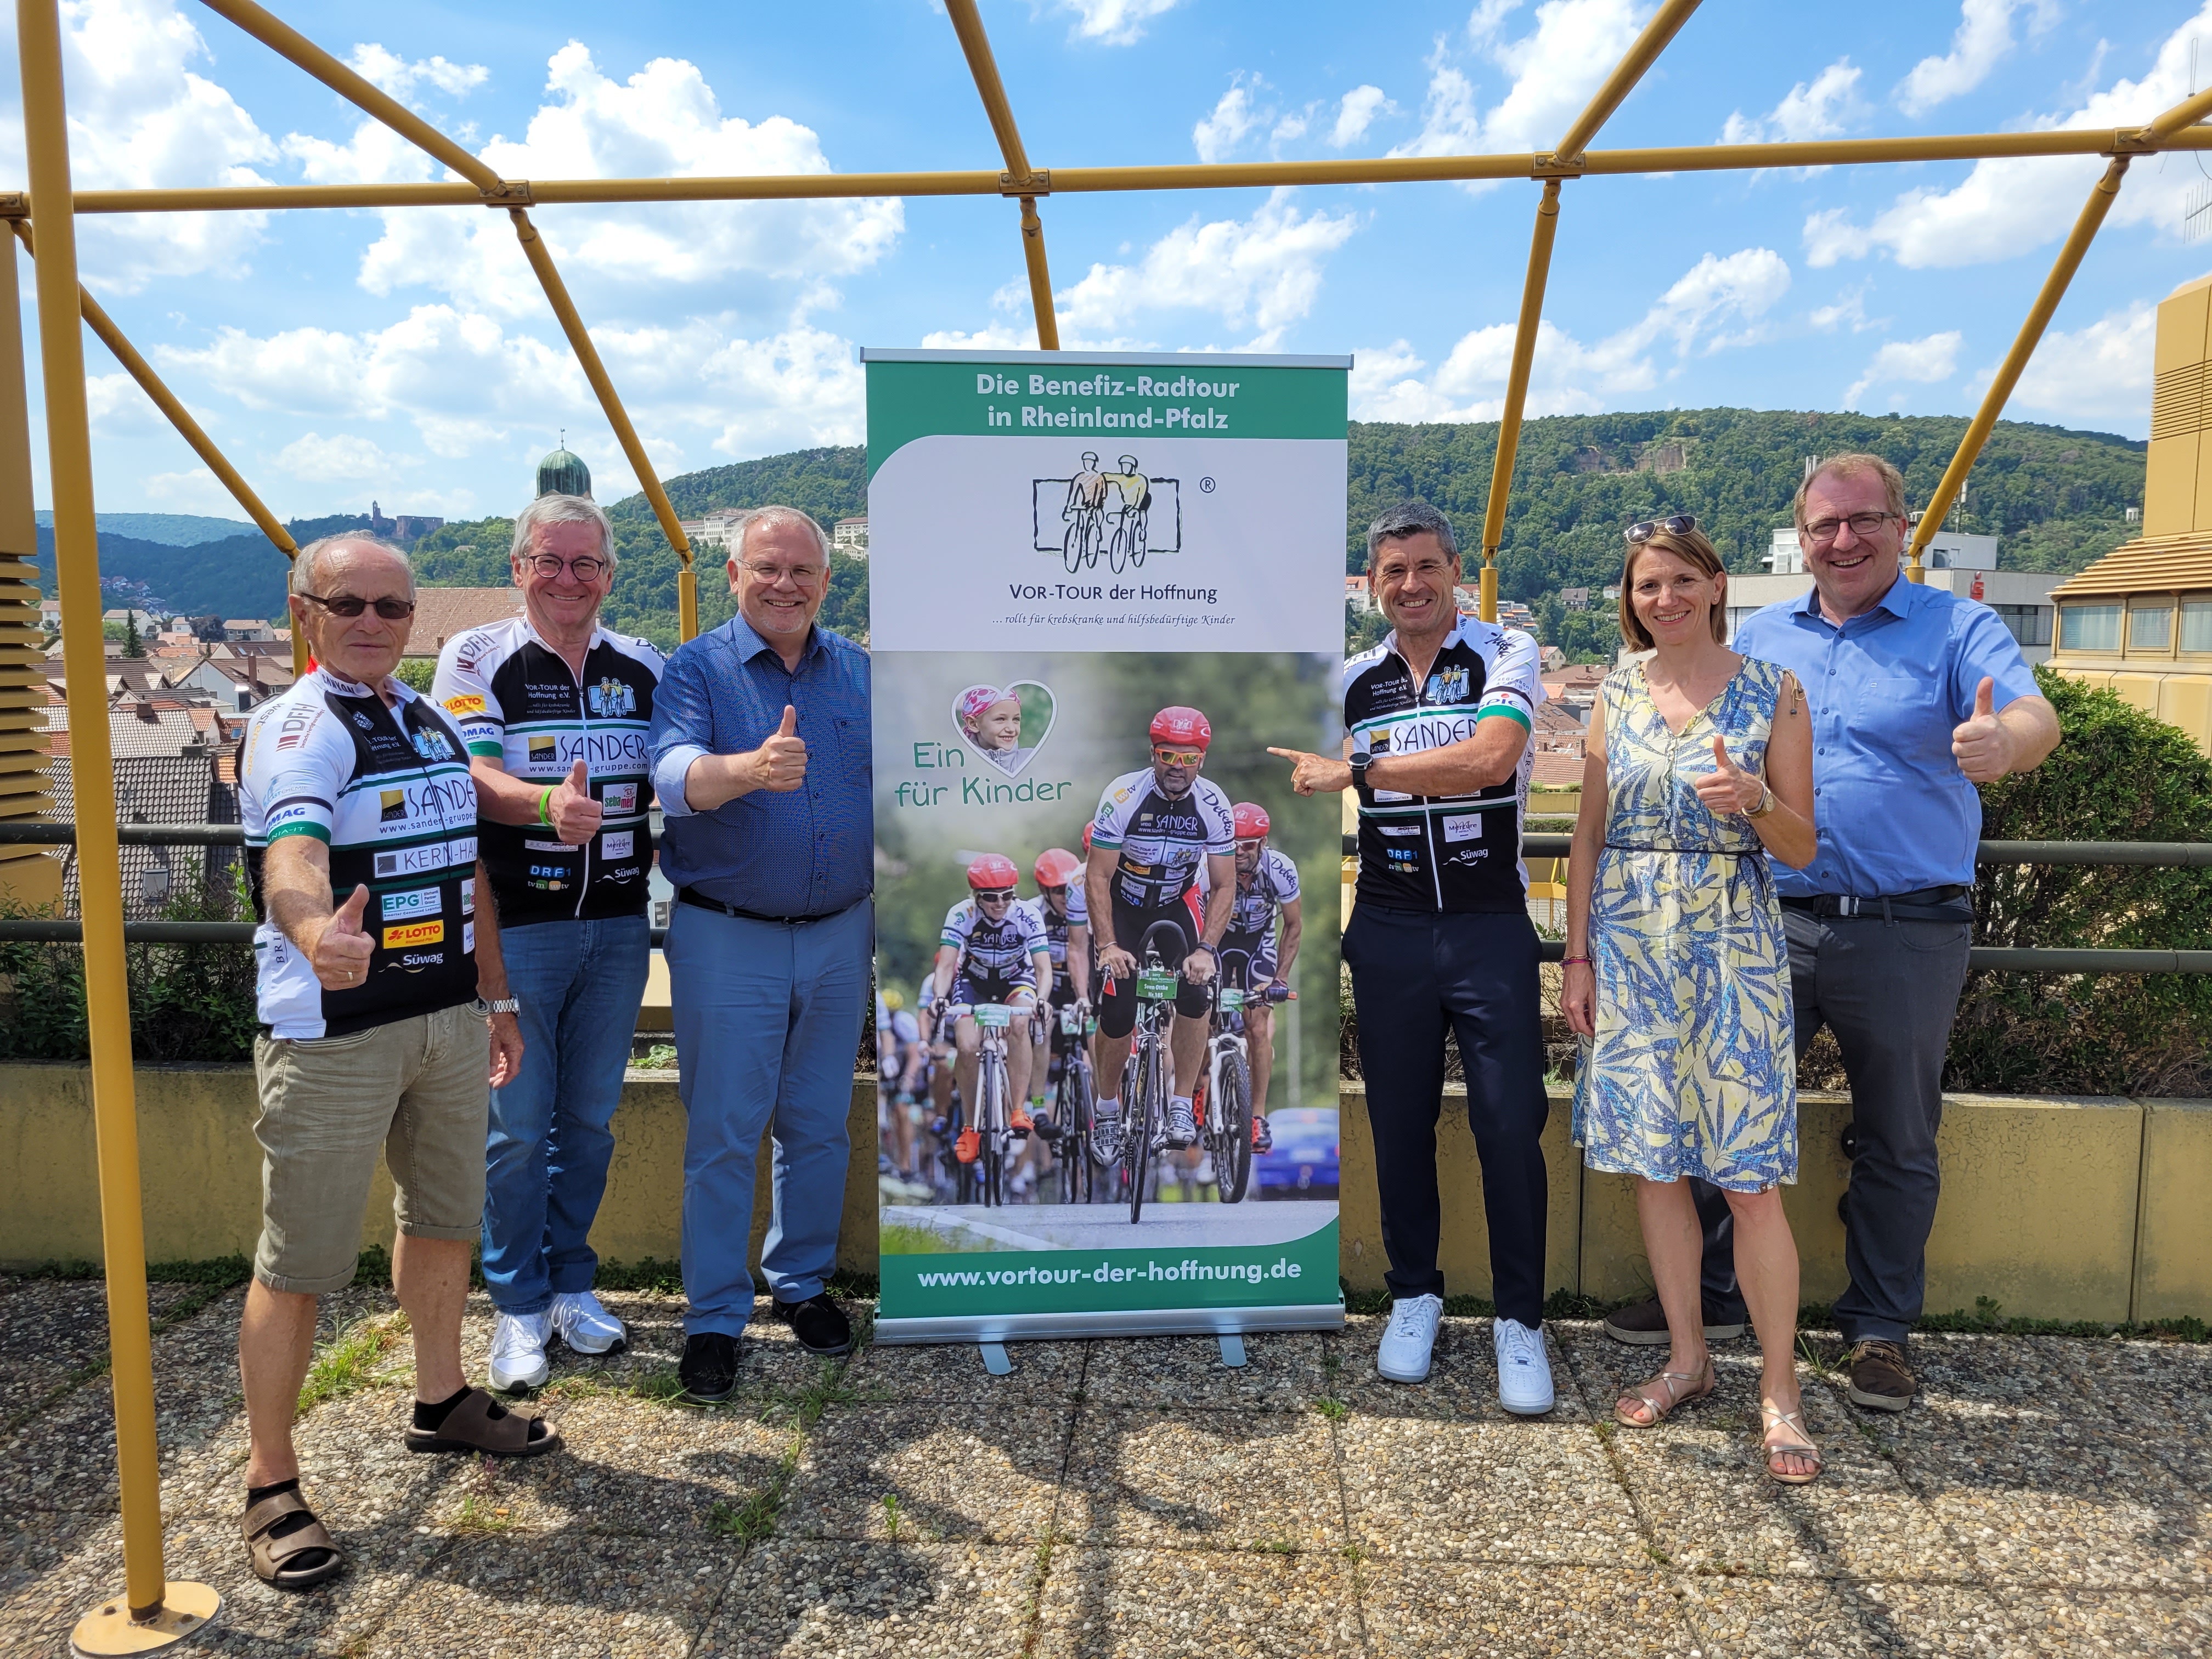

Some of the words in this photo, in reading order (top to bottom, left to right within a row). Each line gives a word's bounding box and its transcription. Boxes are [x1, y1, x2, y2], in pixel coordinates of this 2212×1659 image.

[977, 374, 1019, 395] Die
[1029, 375, 1240, 398] Benefiz-Radtour
[988, 405, 1012, 426] in
[1022, 406, 1229, 430] Rheinland-Pfalz
[1009, 584, 1103, 600] VOR-TOUR
[1109, 584, 1136, 600] der
[1141, 584, 1218, 605] Hoffnung
[1028, 613, 1046, 627] für
[1047, 613, 1104, 625] krebskranke
[1106, 613, 1125, 624] und
[1127, 613, 1199, 627] hilfsbedürftige
[1201, 614, 1236, 626] Kinder
[1370, 679, 1400, 690] VOR-TOUR
[1372, 687, 1396, 697] Hoffnung
[450, 697, 481, 710] LOTTO
[560, 734, 647, 763] SANDER
[913, 742, 965, 768] Ein
[531, 752, 555, 760] SANDER
[894, 781, 949, 808] für
[962, 776, 1073, 806] Kinder
[1202, 788, 1233, 837] Debeka
[1156, 814, 1198, 832] SANDER
[1448, 823, 1477, 831] Mercure
[606, 841, 631, 849] Mercure
[1460, 849, 1488, 860] Süwag
[614, 866, 640, 878] Süwag
[383, 894, 420, 911] EPG
[406, 924, 441, 939] LOTTO
[983, 932, 1018, 945] SANDER
[403, 952, 443, 966] Süwag
[917, 1257, 1302, 1288] www.vortour-der-hoffnung.de
